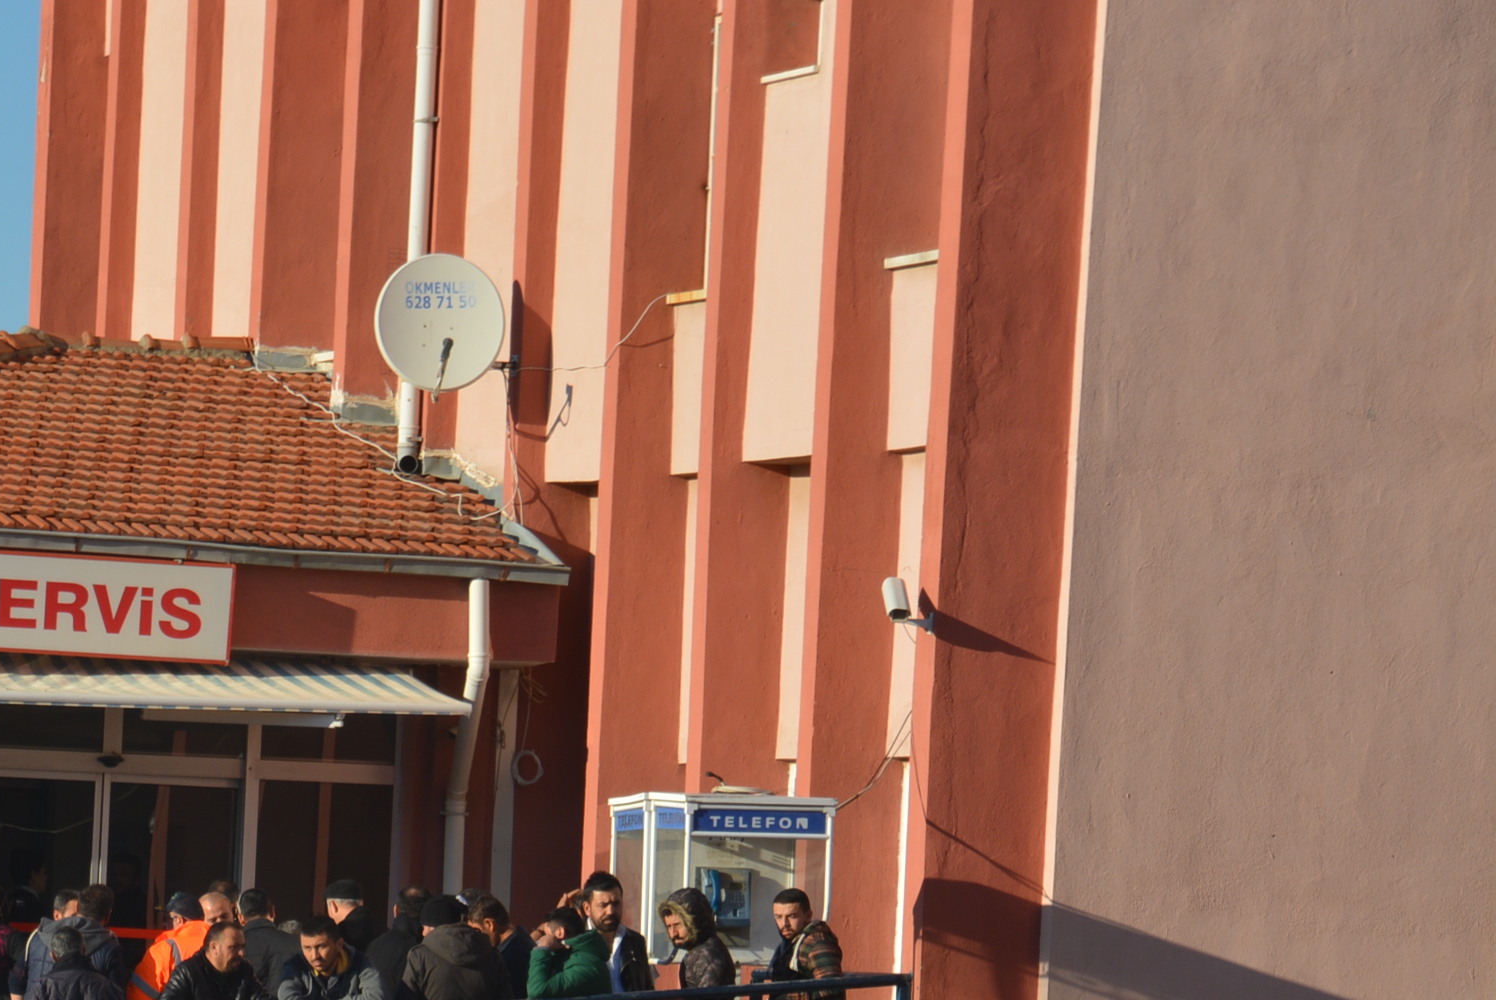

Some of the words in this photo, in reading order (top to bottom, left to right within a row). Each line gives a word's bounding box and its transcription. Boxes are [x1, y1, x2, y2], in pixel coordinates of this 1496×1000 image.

[405, 296, 432, 309] 628
[436, 296, 453, 309] 71
[710, 816, 808, 829] TELEFON
